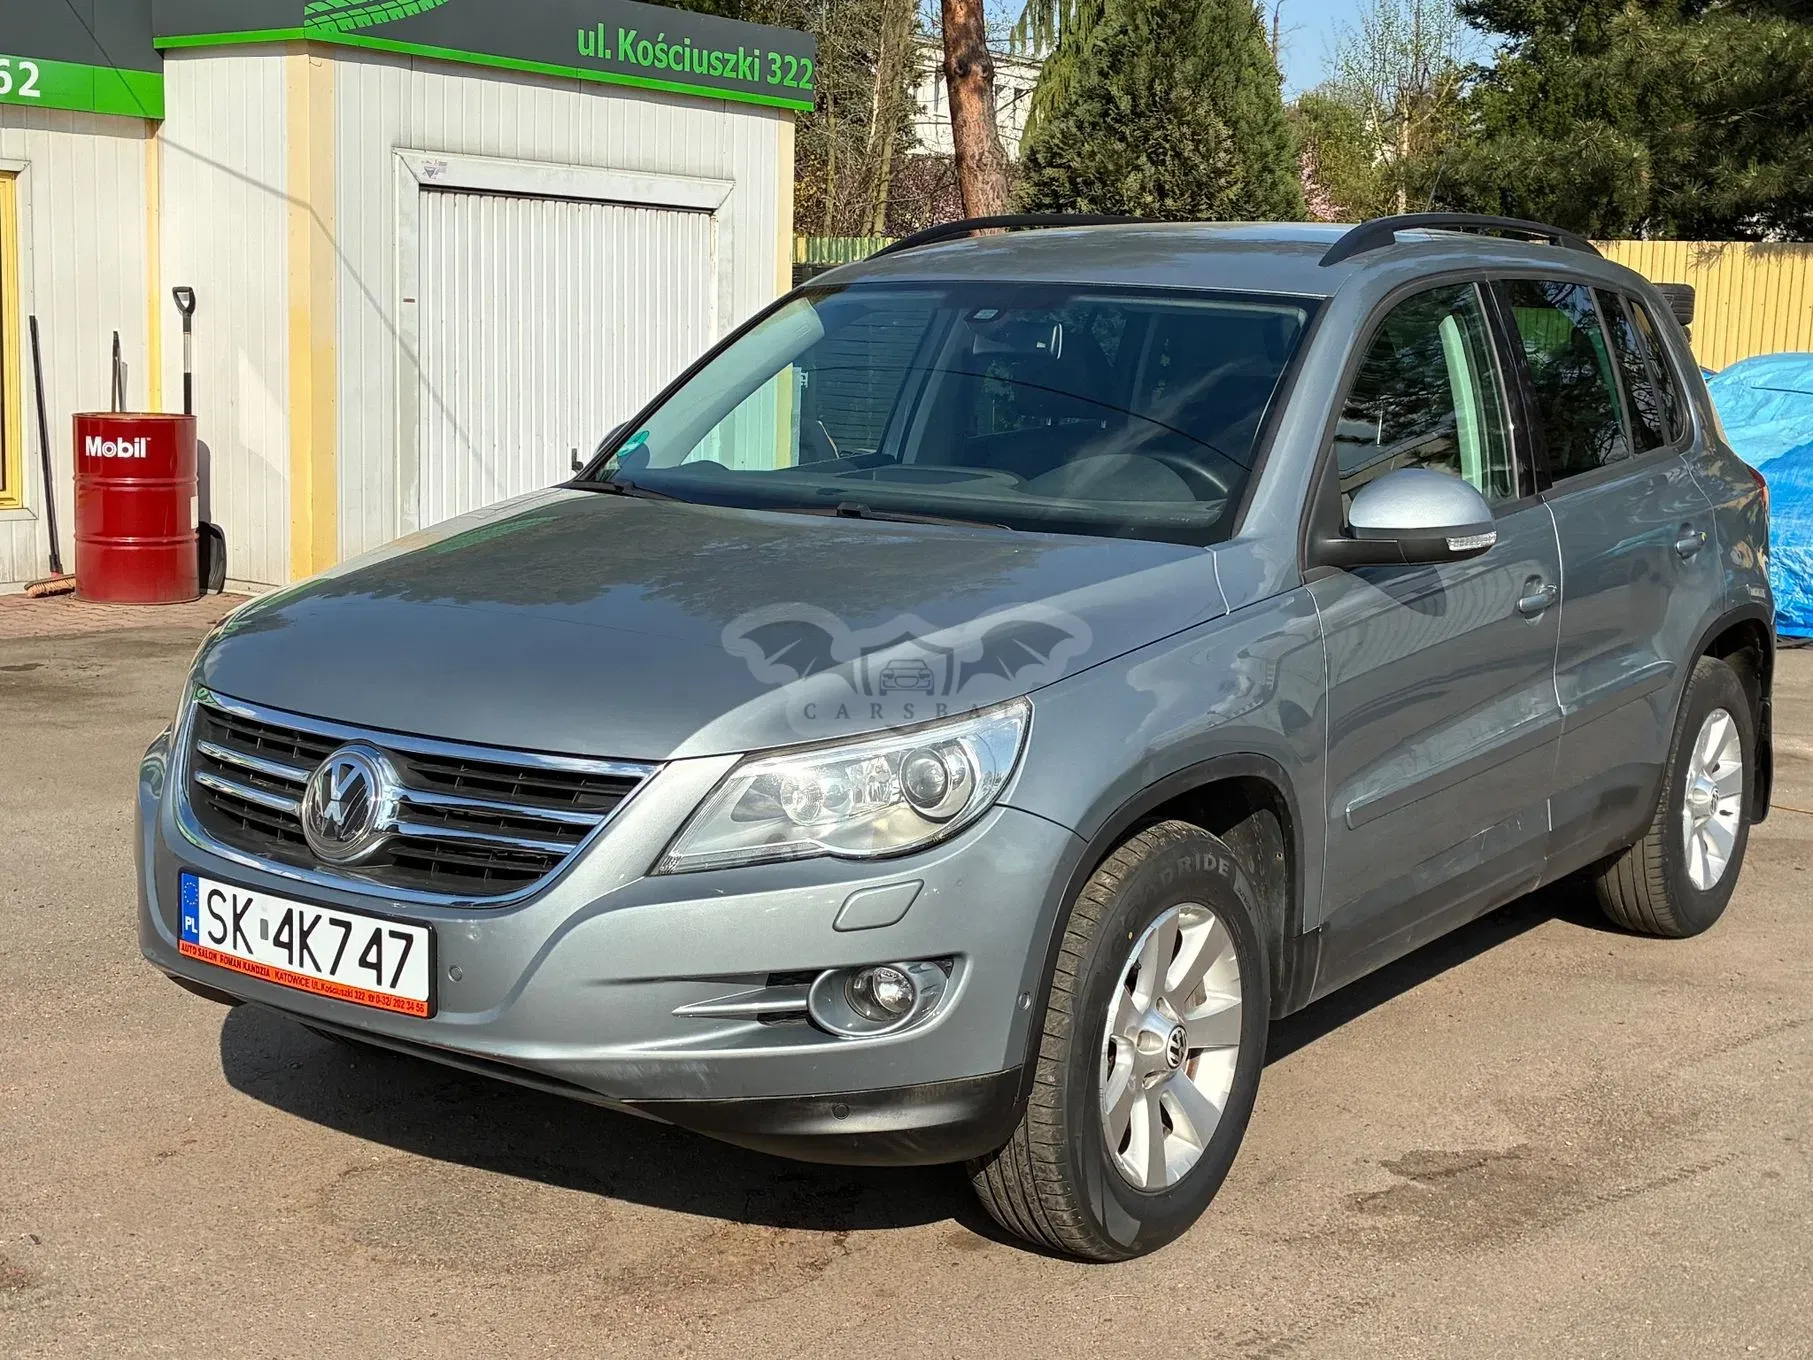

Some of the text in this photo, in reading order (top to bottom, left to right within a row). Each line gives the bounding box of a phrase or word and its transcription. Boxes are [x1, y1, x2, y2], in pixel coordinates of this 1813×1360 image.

[577, 22, 813, 90] ul. Kościuszki 322
[85, 435, 147, 458] Mobil
[185, 915, 199, 934] PL
[207, 888, 415, 989] SK 4K747
[181, 943, 197, 955] AUTO
[196, 947, 218, 962] SALON
[219, 953, 241, 971] ROMAN
[242, 960, 271, 979] KANDZIA
[274, 971, 311, 989] KATOWICE
